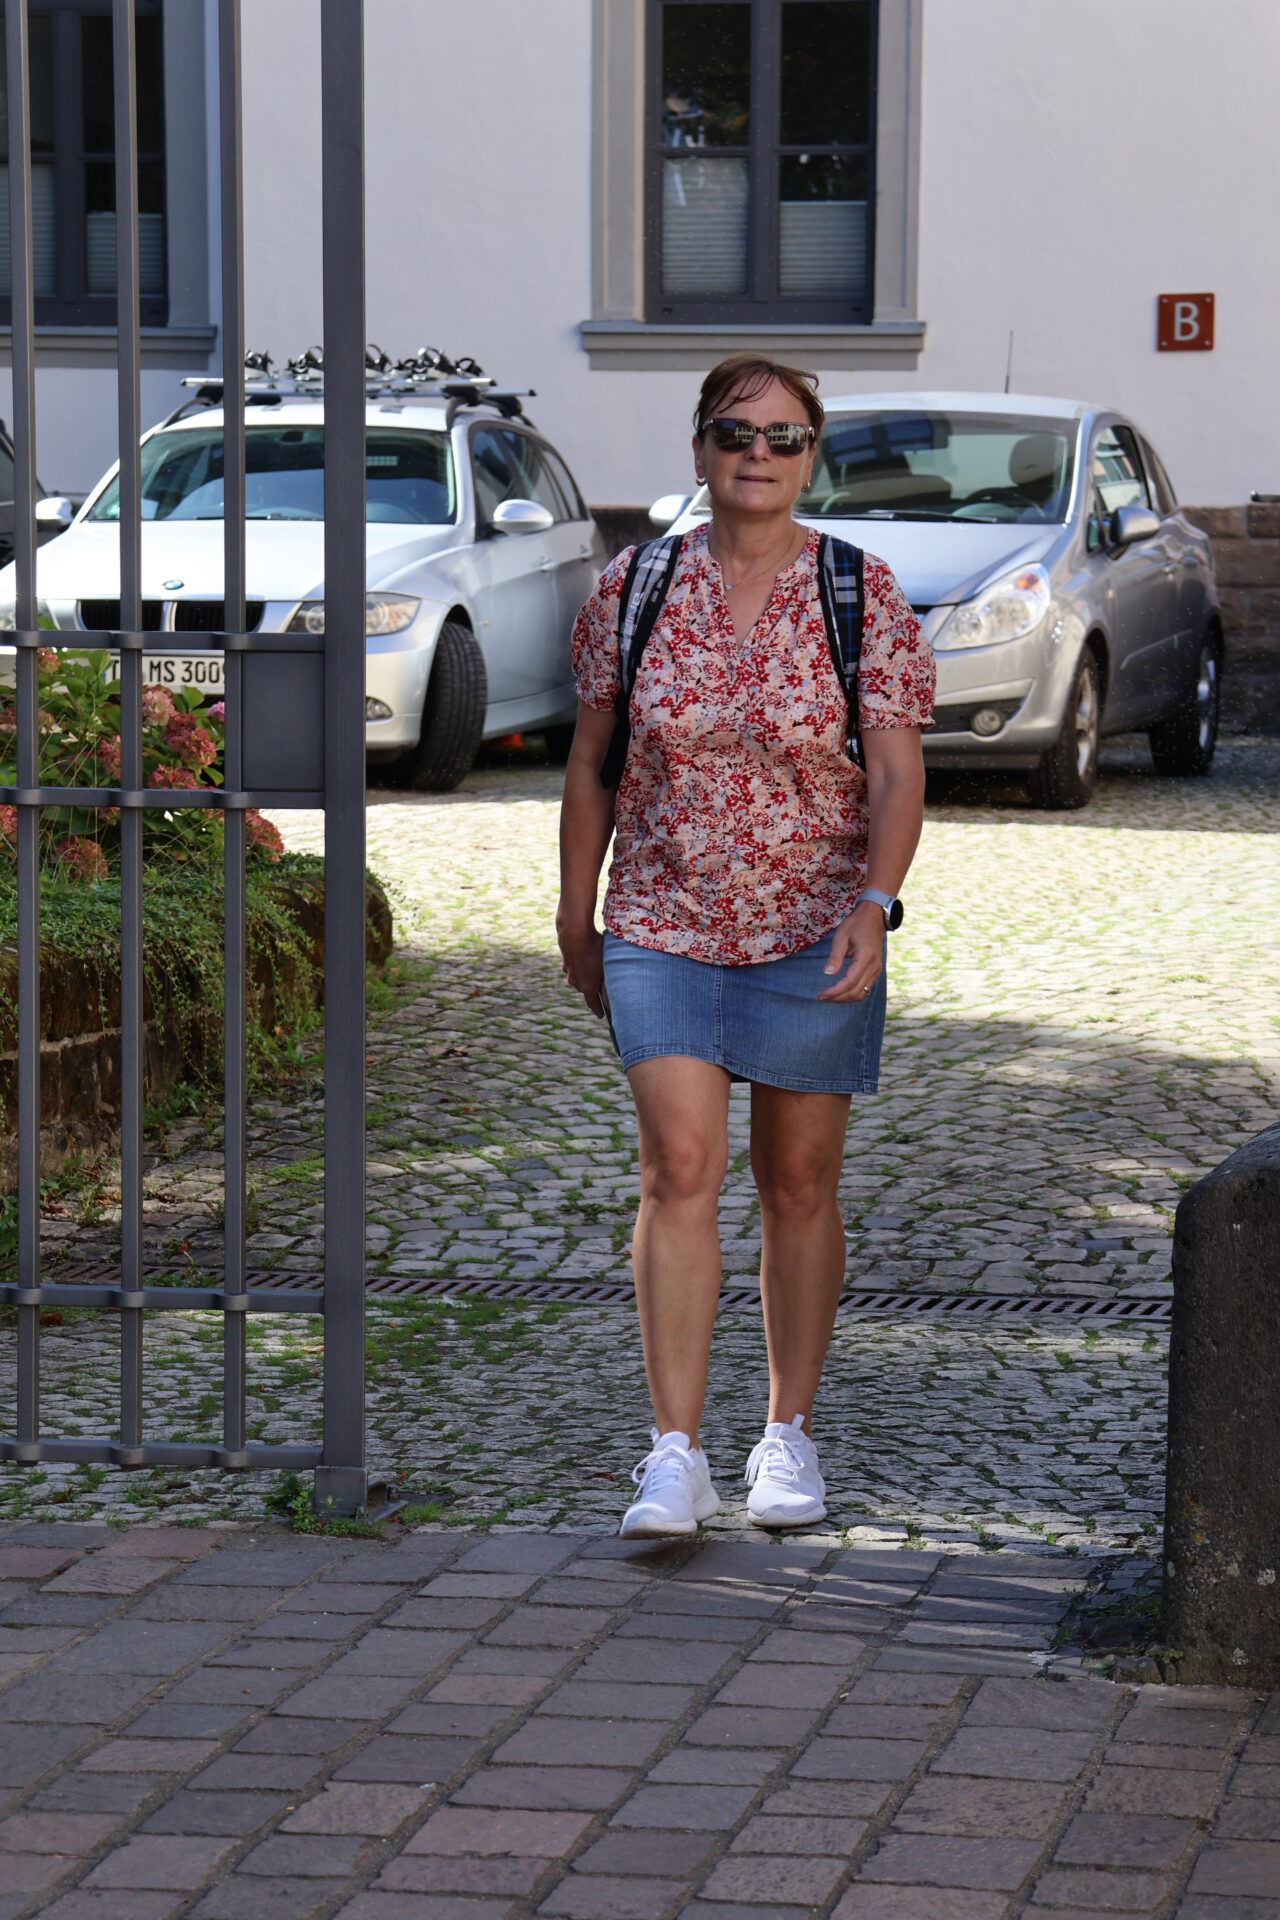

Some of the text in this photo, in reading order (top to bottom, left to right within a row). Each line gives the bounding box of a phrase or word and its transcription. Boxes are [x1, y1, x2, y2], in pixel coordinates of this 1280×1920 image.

[1174, 301, 1199, 341] B
[149, 660, 175, 683] MS
[181, 660, 225, 684] 300
